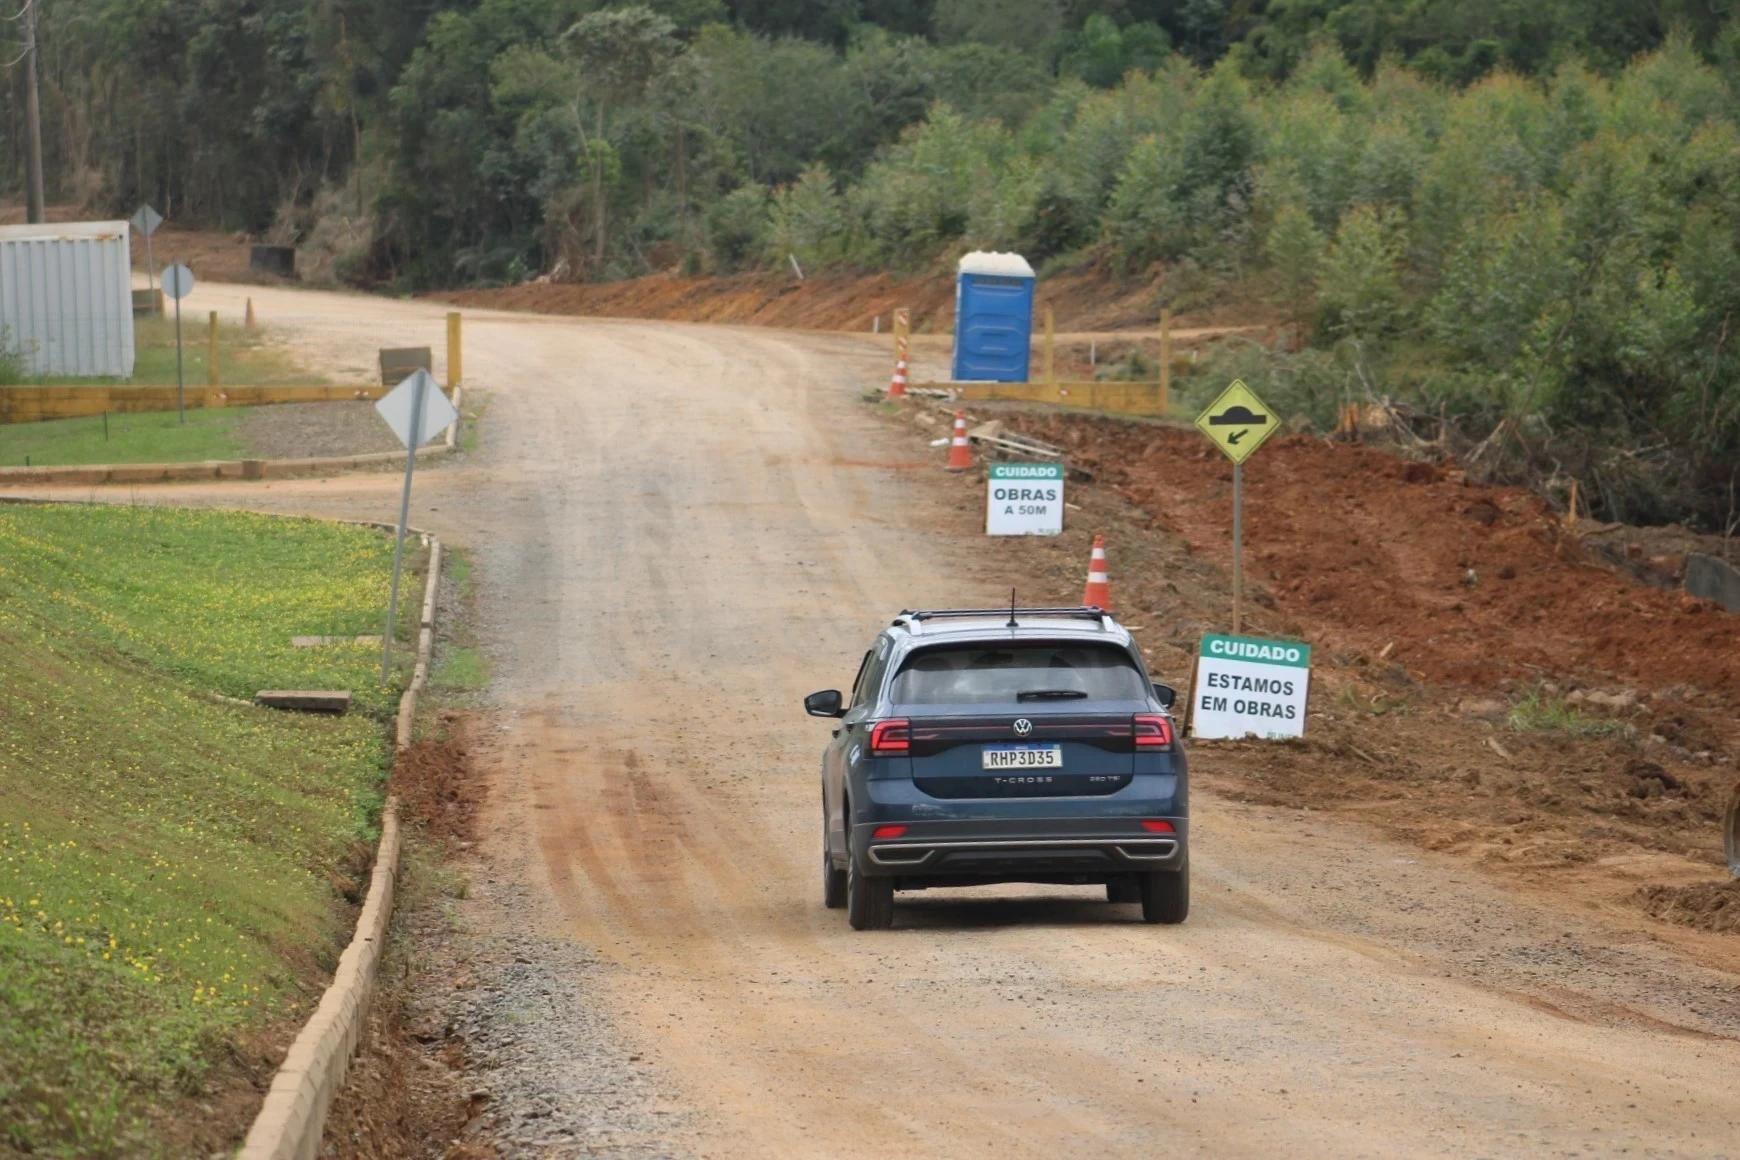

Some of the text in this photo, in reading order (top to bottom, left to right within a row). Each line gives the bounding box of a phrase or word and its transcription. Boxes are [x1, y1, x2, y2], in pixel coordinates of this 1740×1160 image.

[995, 466, 1057, 477] CUIDADO
[994, 488, 1057, 501] OBRAS
[1004, 505, 1047, 515] A 50M
[1210, 640, 1300, 662] CUIDADO
[1207, 672, 1294, 696] ESTAMOS
[1201, 695, 1296, 720] EM OBRAS
[990, 751, 1054, 766] RHP3D35
[994, 776, 1053, 784] T-CROSS
